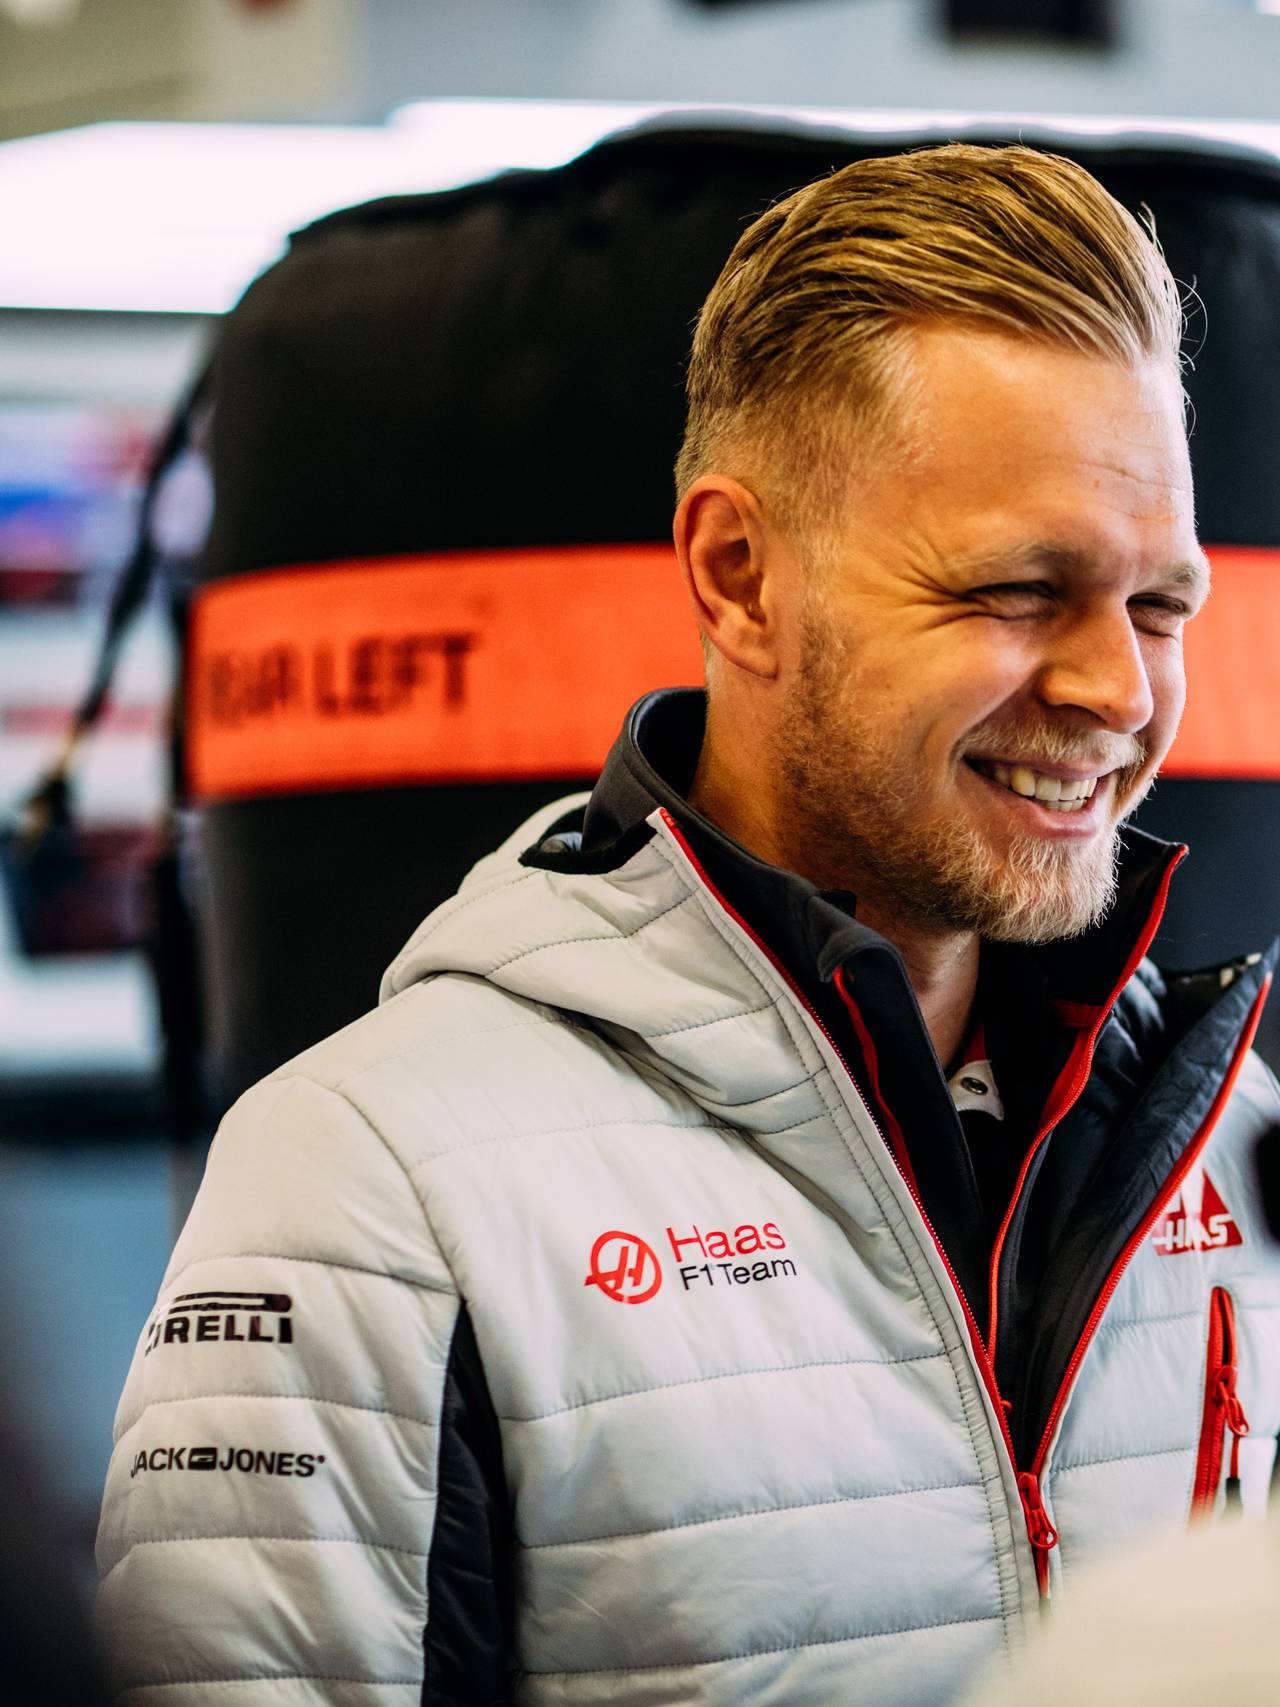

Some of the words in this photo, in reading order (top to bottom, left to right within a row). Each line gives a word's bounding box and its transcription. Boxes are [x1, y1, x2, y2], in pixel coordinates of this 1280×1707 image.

[313, 630, 478, 716] LEFT
[666, 1221, 786, 1263] Haas
[679, 1264, 714, 1291] F1
[717, 1257, 797, 1285] Team
[131, 1447, 187, 1478] JACK
